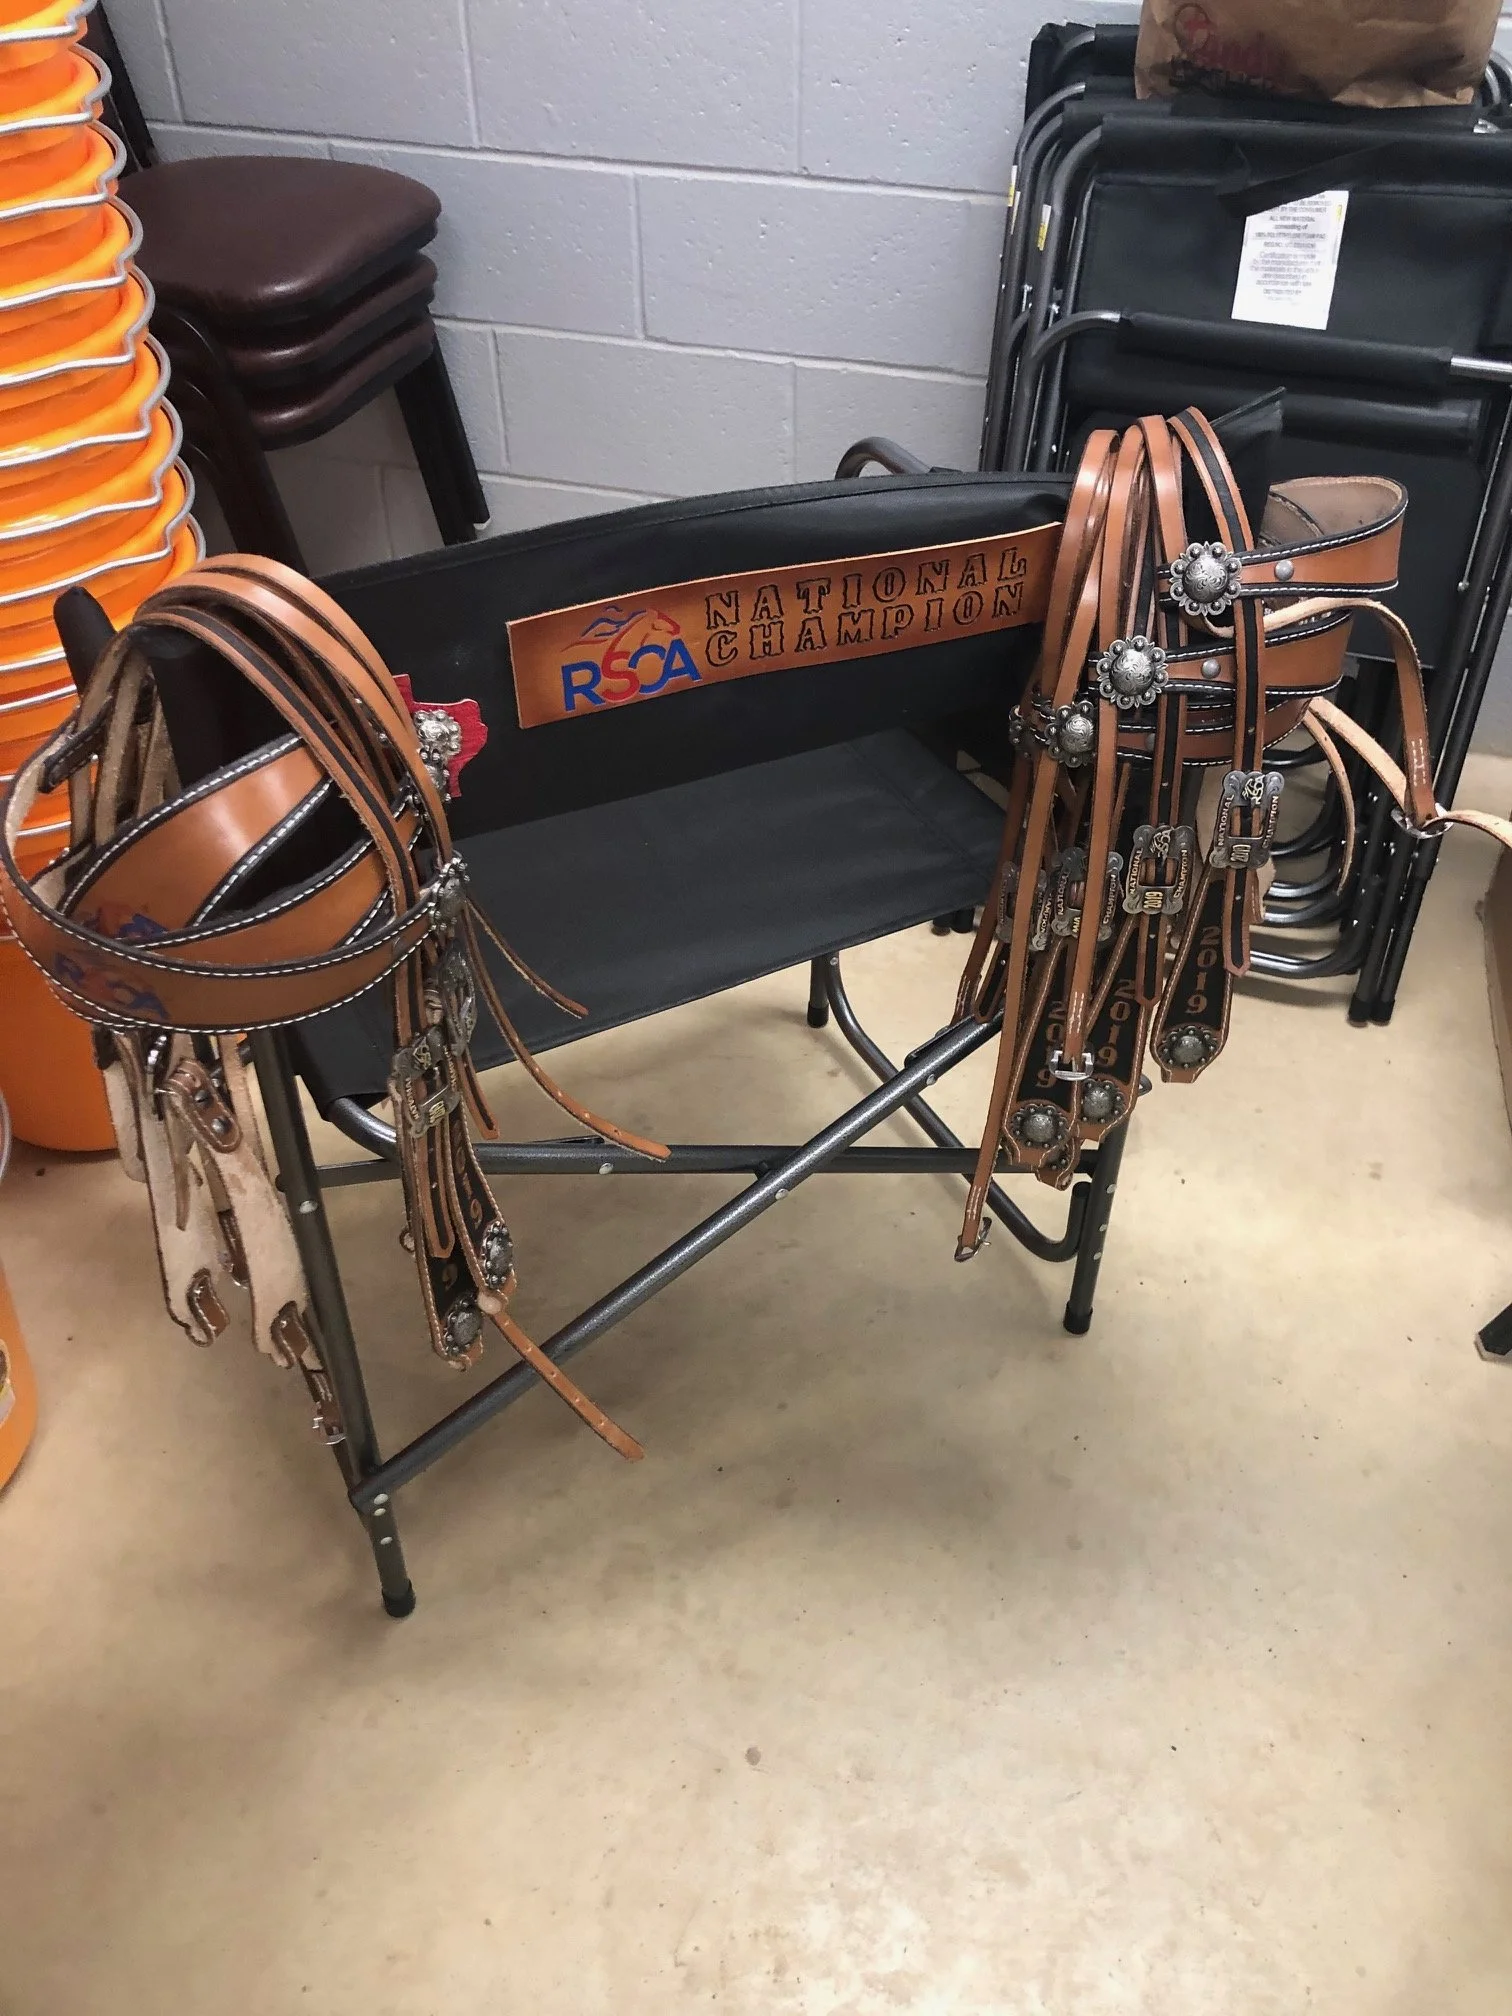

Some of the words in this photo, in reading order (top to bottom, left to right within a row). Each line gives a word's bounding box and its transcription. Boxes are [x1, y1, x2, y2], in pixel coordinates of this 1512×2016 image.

[705, 546, 1028, 630] NATIONAL
[705, 582, 1024, 667] CHAMPION
[561, 638, 703, 712] RSCA
[1217, 794, 1235, 846] NATIONAL
[1129, 847, 1144, 895] NATIONAL
[1142, 891, 1164, 909] 2019
[1185, 926, 1221, 1014] 2019
[1034, 1001, 1066, 1088] 209
[1099, 979, 1136, 1067] 2019
